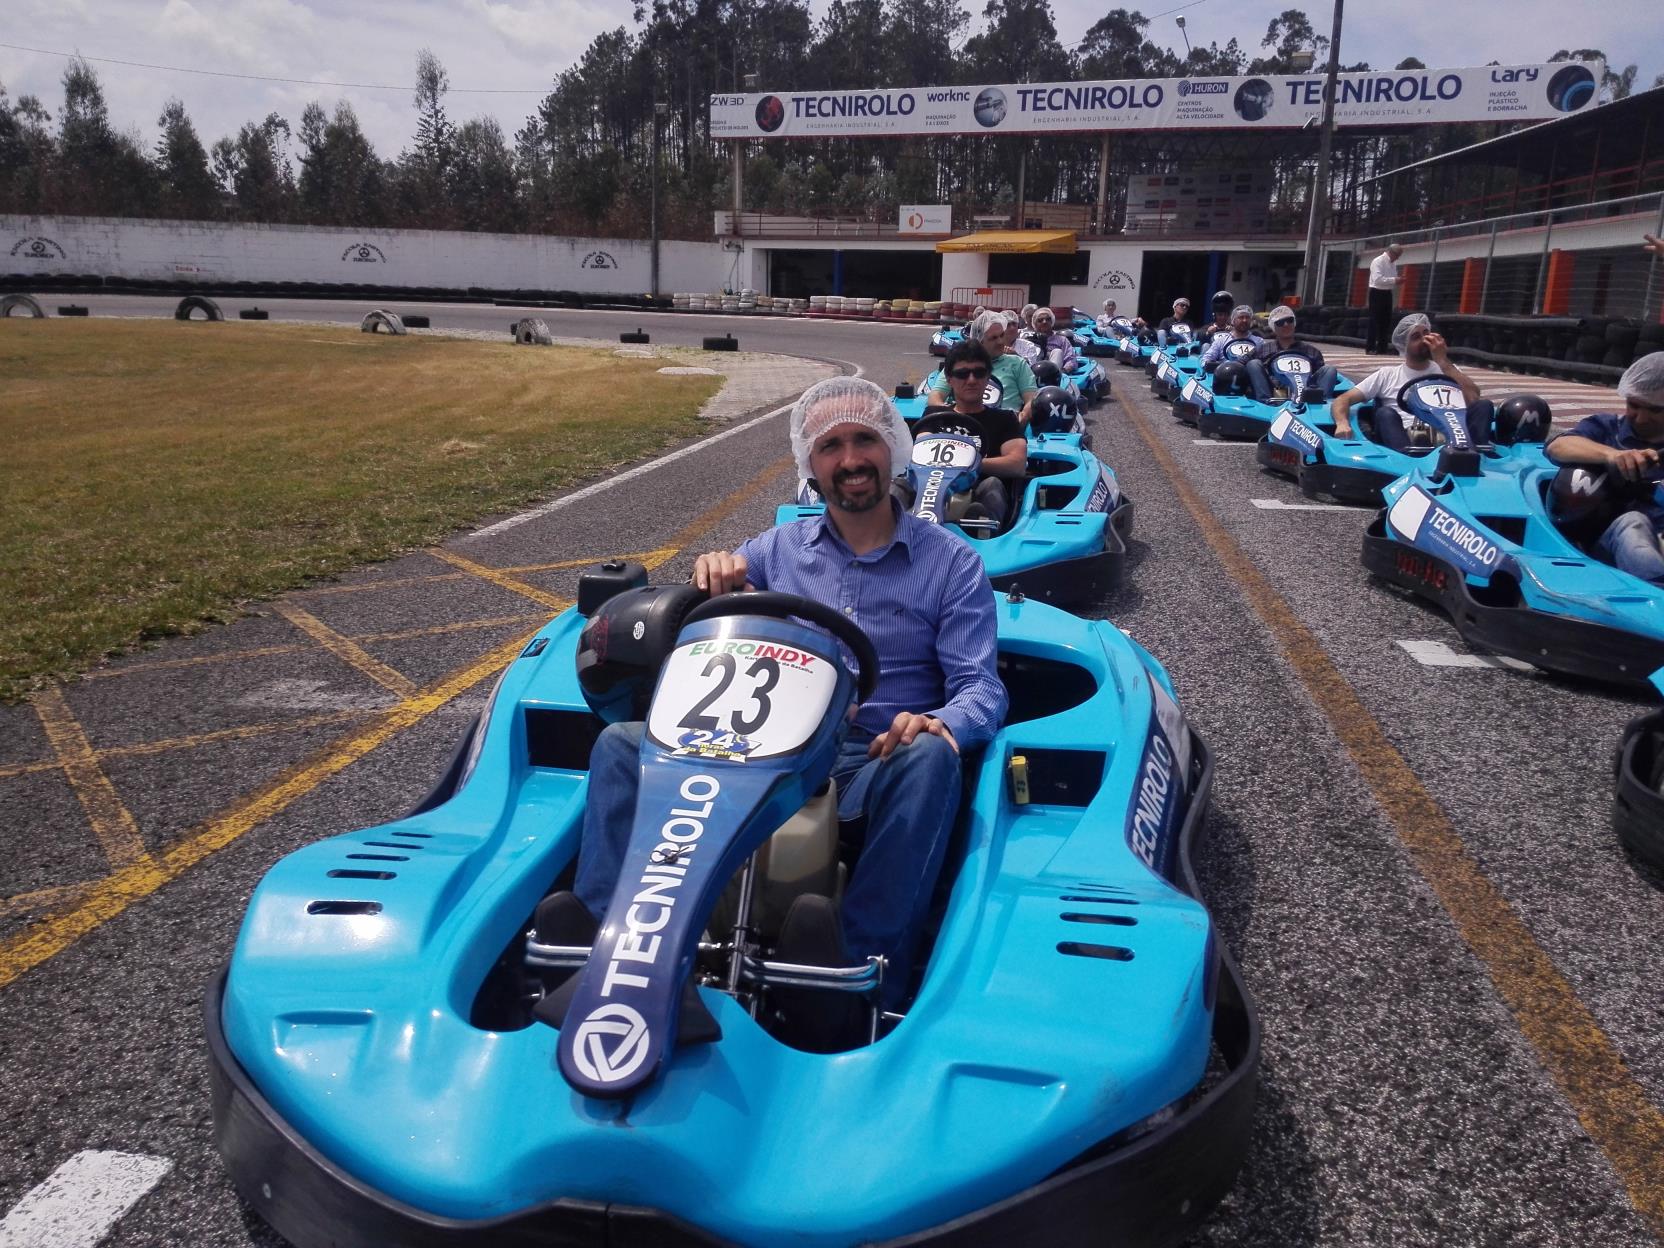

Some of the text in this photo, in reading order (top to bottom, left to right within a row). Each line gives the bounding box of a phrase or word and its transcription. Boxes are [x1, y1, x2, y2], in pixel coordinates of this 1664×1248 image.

[927, 89, 970, 102] worknc
[1017, 84, 1164, 111] TECNIROLO
[1194, 83, 1226, 93] HURON
[1286, 75, 1462, 105] TECNIROLO
[792, 93, 915, 118] TECNIROLO
[1239, 345, 1249, 354] 14
[1287, 360, 1301, 371] 13
[1433, 388, 1451, 406] 17
[1049, 402, 1074, 418] XL
[931, 443, 955, 464] 16
[1428, 507, 1497, 565] TECNIROLO
[689, 642, 816, 667] EUROINDY
[676, 652, 780, 735] 23
[689, 730, 735, 749] 24
[1132, 735, 1172, 867] ECNIROLO
[601, 775, 720, 997] TECNIROLO
